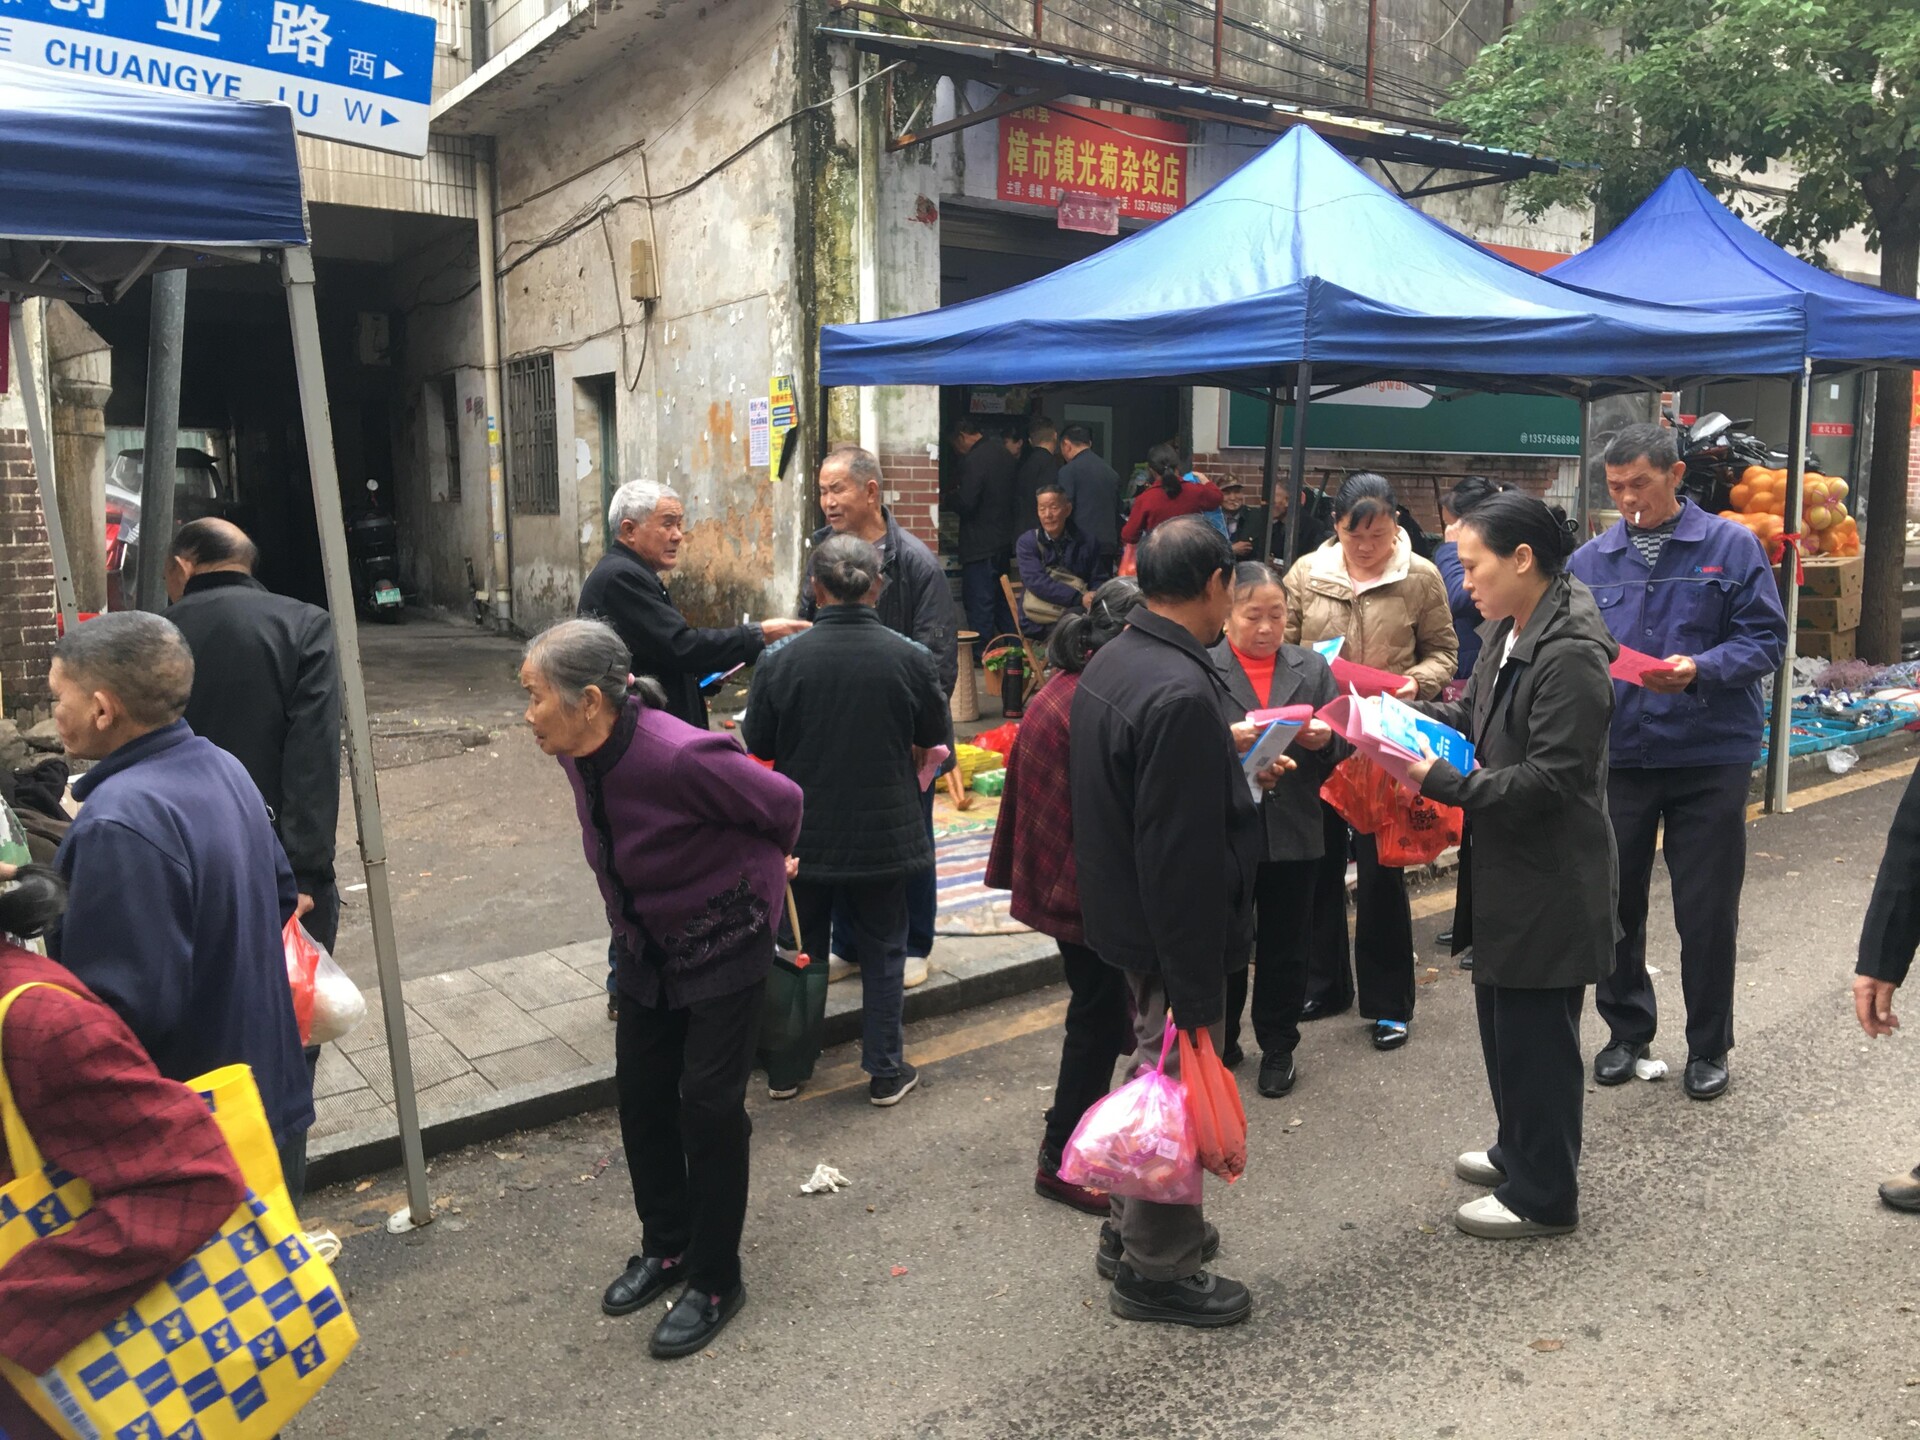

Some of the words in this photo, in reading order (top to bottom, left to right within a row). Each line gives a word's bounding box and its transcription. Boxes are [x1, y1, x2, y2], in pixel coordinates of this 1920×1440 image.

[45, 38, 242, 99] CHUANGYE
[344, 97, 373, 125] W
[348, 48, 377, 80] 西
[1007, 126, 1181, 199] 樟市镇光菊杂货店
[1529, 433, 1580, 446] 13574566994
